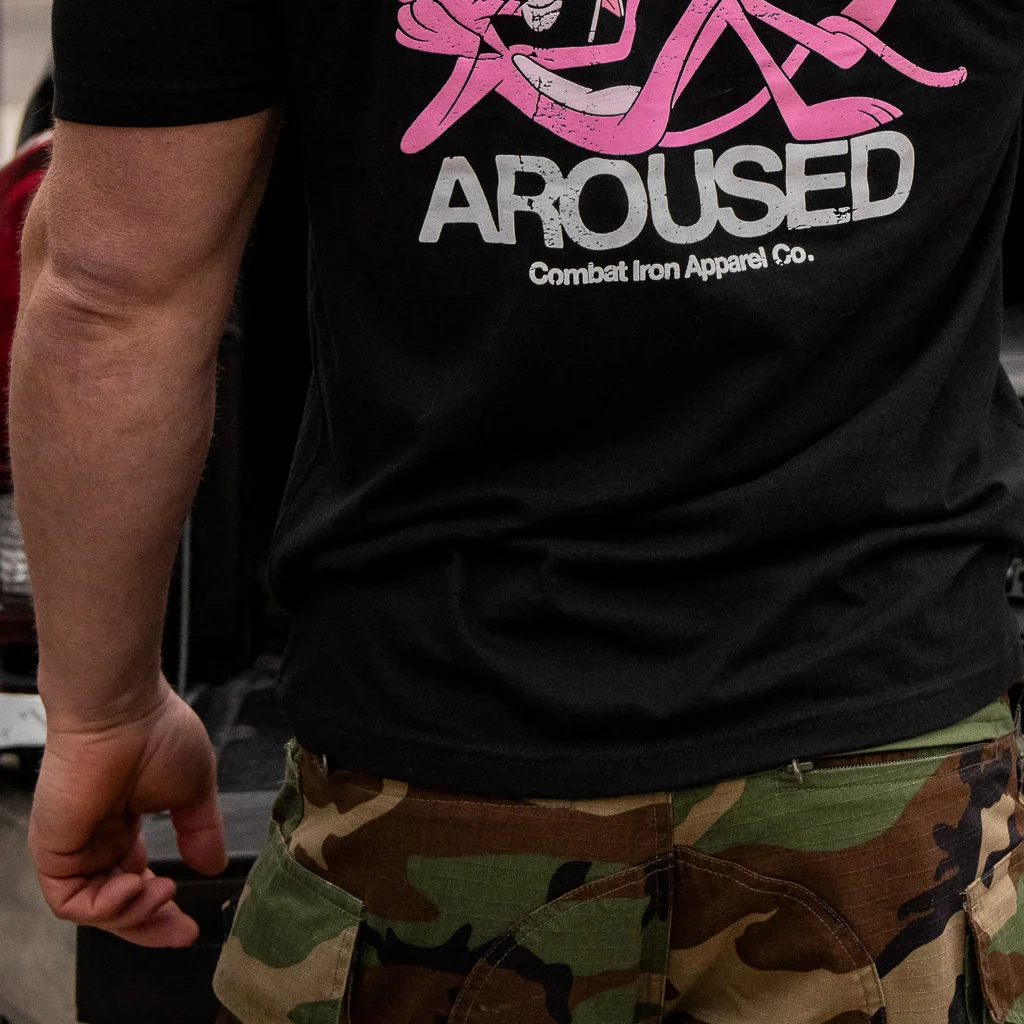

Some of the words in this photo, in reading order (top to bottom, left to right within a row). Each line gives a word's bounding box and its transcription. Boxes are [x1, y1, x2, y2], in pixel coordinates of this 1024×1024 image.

[418, 130, 915, 251] AROUSED
[528, 260, 629, 286] Combat
[632, 259, 681, 282] Iron
[684, 246, 768, 282] Apparel
[771, 242, 815, 266] Co.
